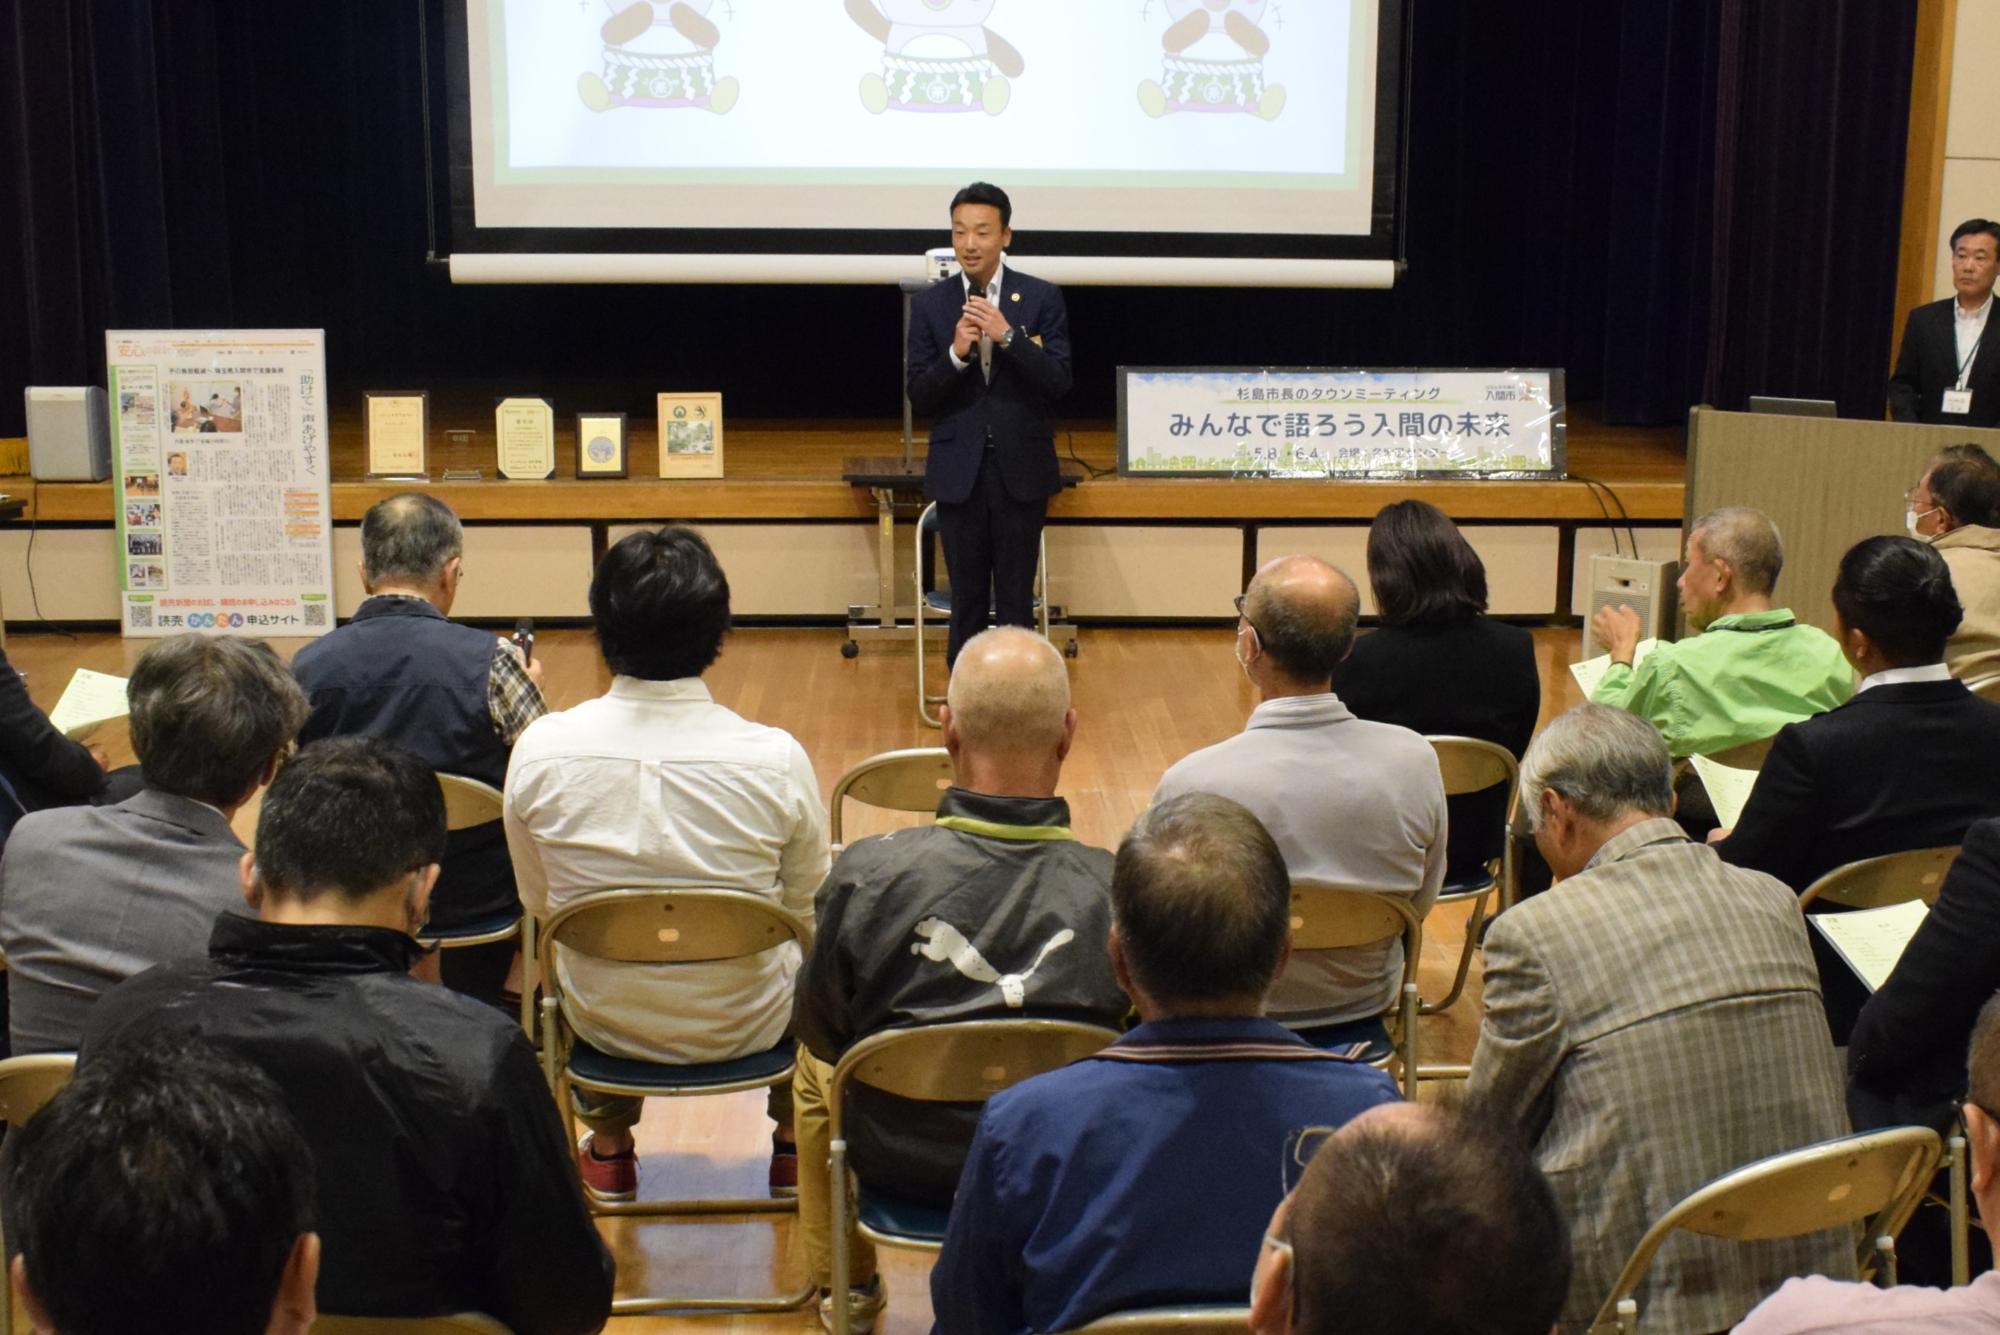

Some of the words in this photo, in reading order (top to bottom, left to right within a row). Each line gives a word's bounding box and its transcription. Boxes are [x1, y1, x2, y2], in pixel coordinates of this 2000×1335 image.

[1237, 387, 1441, 400] 杉島市長のタウンミーティング
[1486, 390, 1516, 400] 入間市
[1169, 412, 1511, 437] みんなで語ろう入間の未来
[157, 615, 184, 627] 読売
[246, 614, 299, 626] 申込サイト
